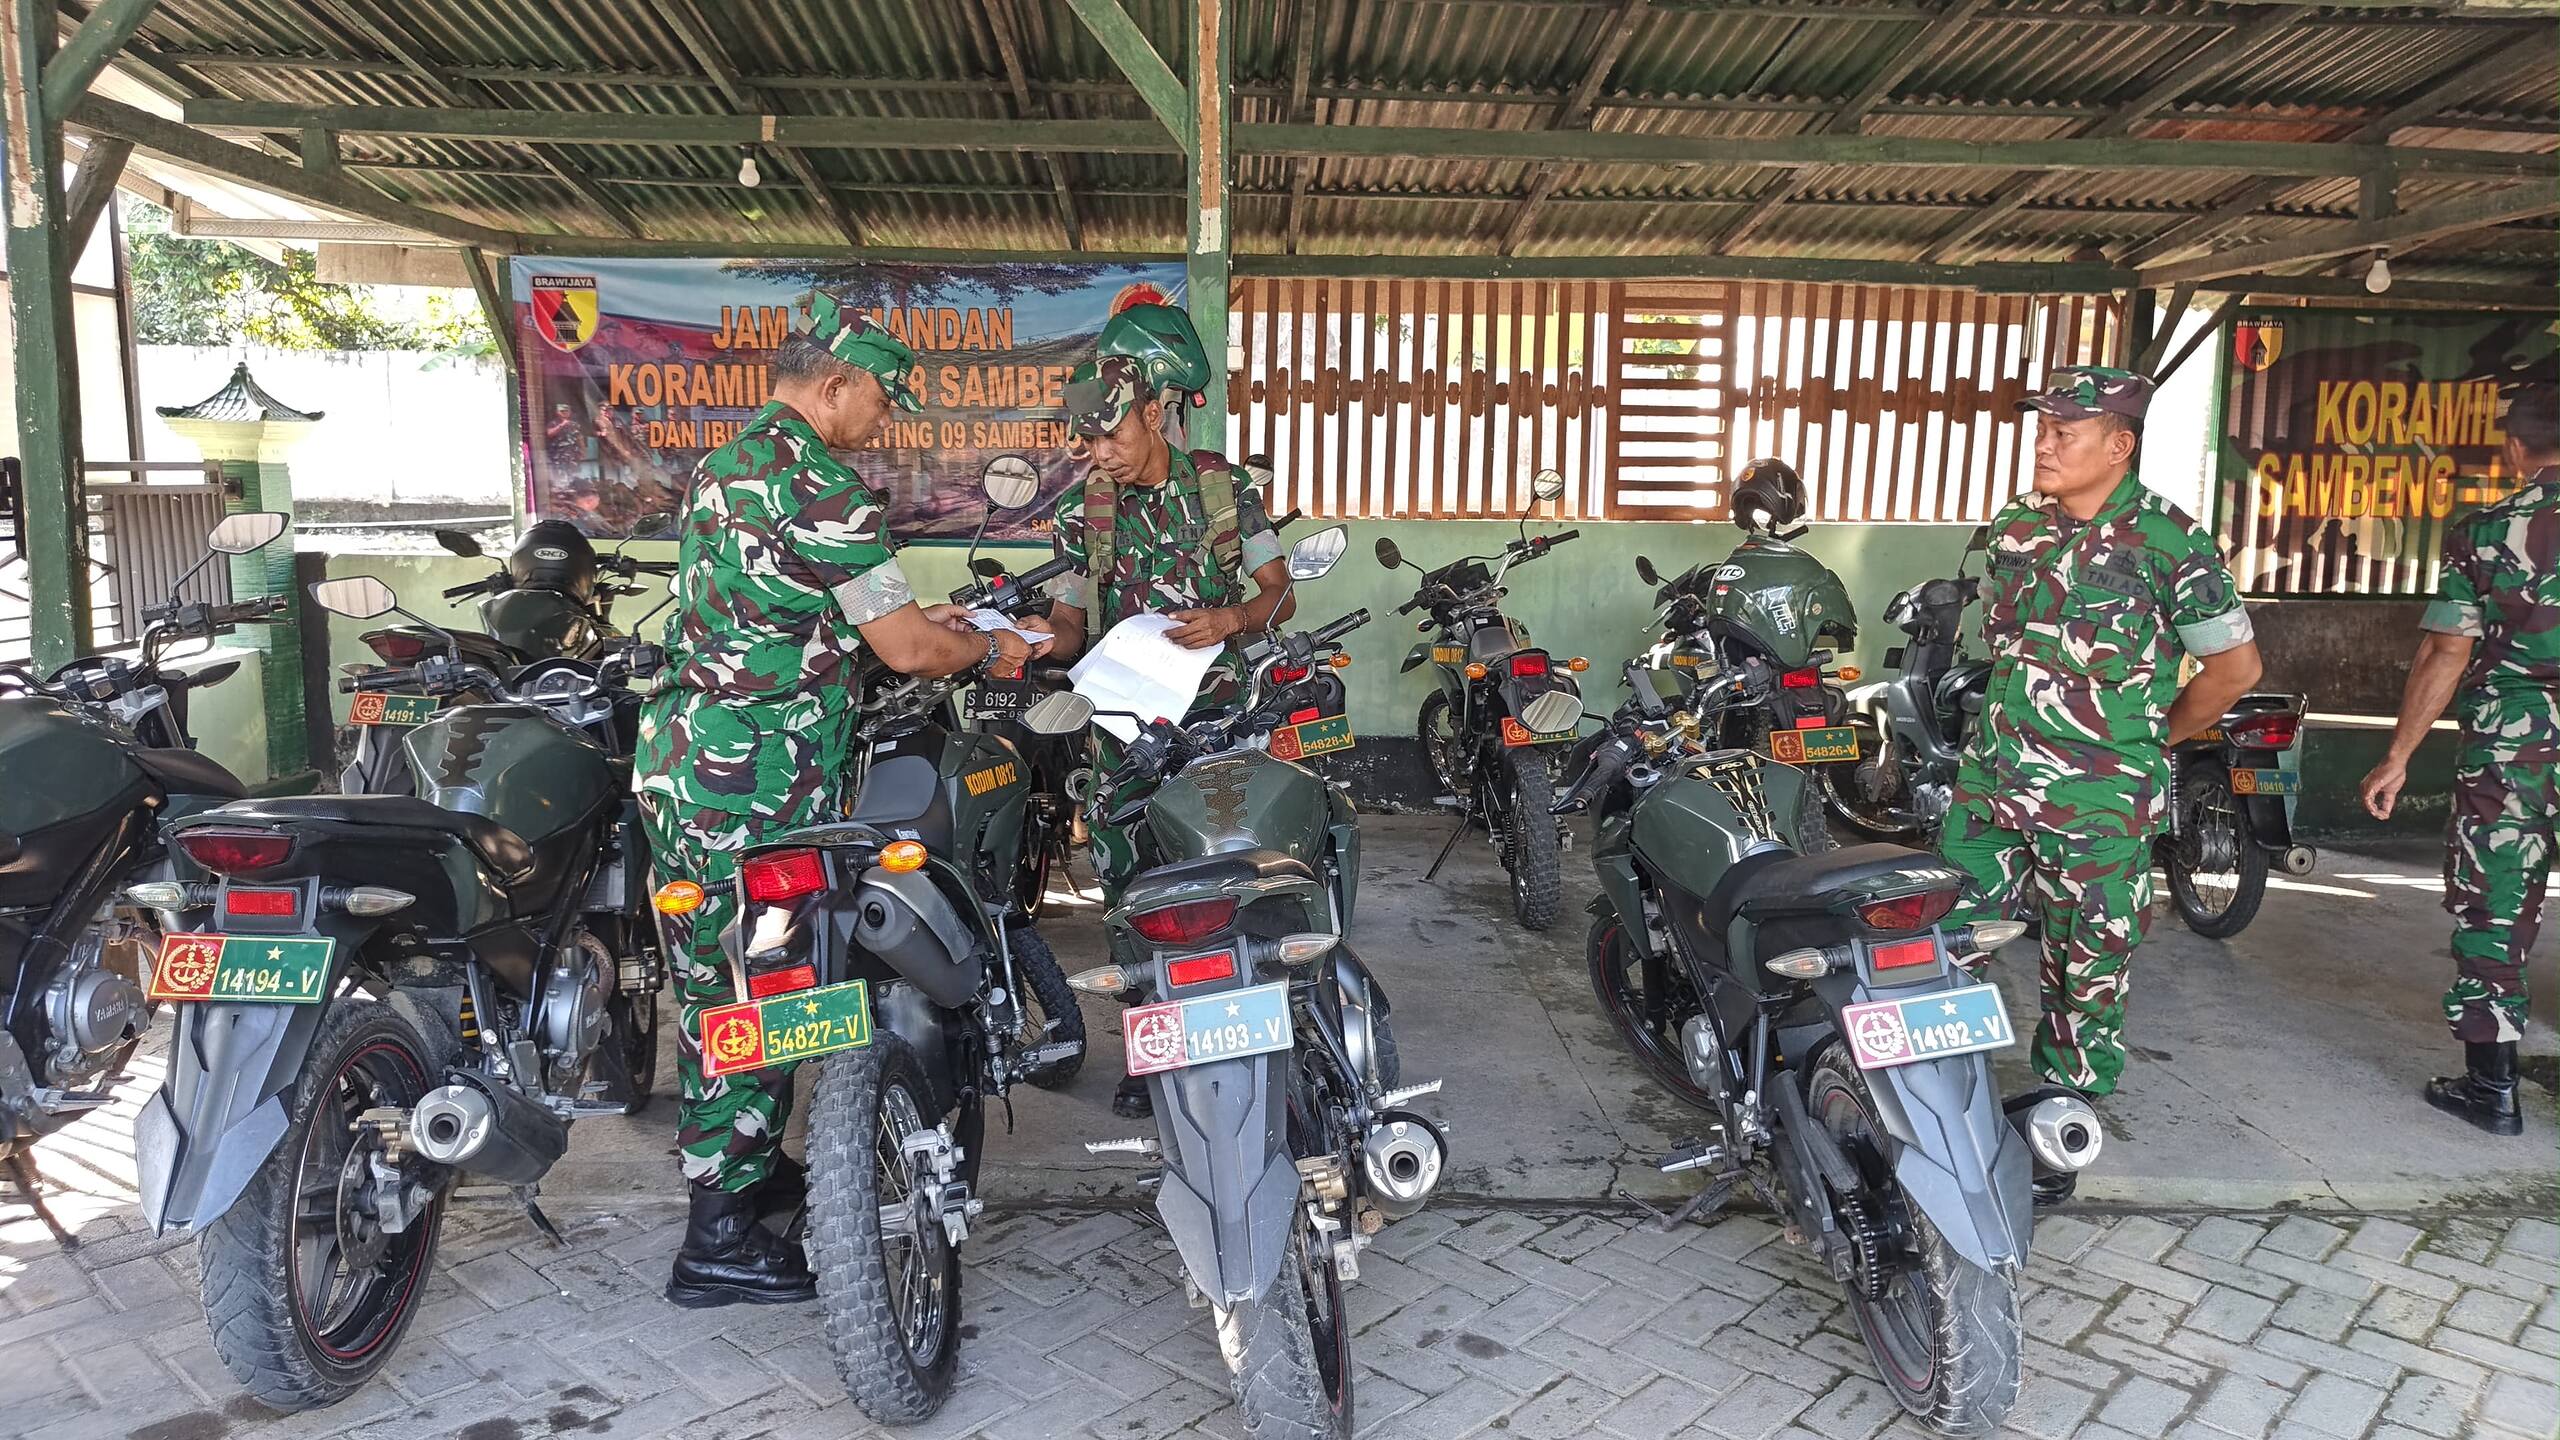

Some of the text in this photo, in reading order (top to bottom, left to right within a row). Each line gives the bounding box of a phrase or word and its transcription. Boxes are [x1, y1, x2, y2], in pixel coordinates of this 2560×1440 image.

[534, 276, 594, 288] BRAWIJAYA
[712, 305, 1014, 350] JAM ANDAN
[2236, 320, 2284, 328] BRAWIJAYA
[609, 363, 775, 407] KORAMIL
[939, 365, 1074, 408] SAMBE
[2314, 380, 2507, 446] KORAMIL
[650, 420, 697, 448] DAN
[941, 421, 967, 449] 09
[2255, 453, 2456, 521] SAMBENG
[2087, 570, 2115, 586] TNI
[967, 692, 977, 706] S
[985, 692, 1017, 707] 6192
[384, 709, 415, 722] 14191
[1303, 732, 1352, 752] 54828-V
[1806, 744, 1857, 758] 54826-V
[964, 761, 1017, 797] KODIM 0812
[221, 968, 282, 993] 14194
[302, 969, 318, 994] V
[768, 1014, 859, 1055] 54827-V
[1190, 1023, 1250, 1056] 14193
[1265, 1016, 1281, 1042] V
[1912, 1020, 1974, 1052] 14192
[1982, 1015, 2000, 1040] V
